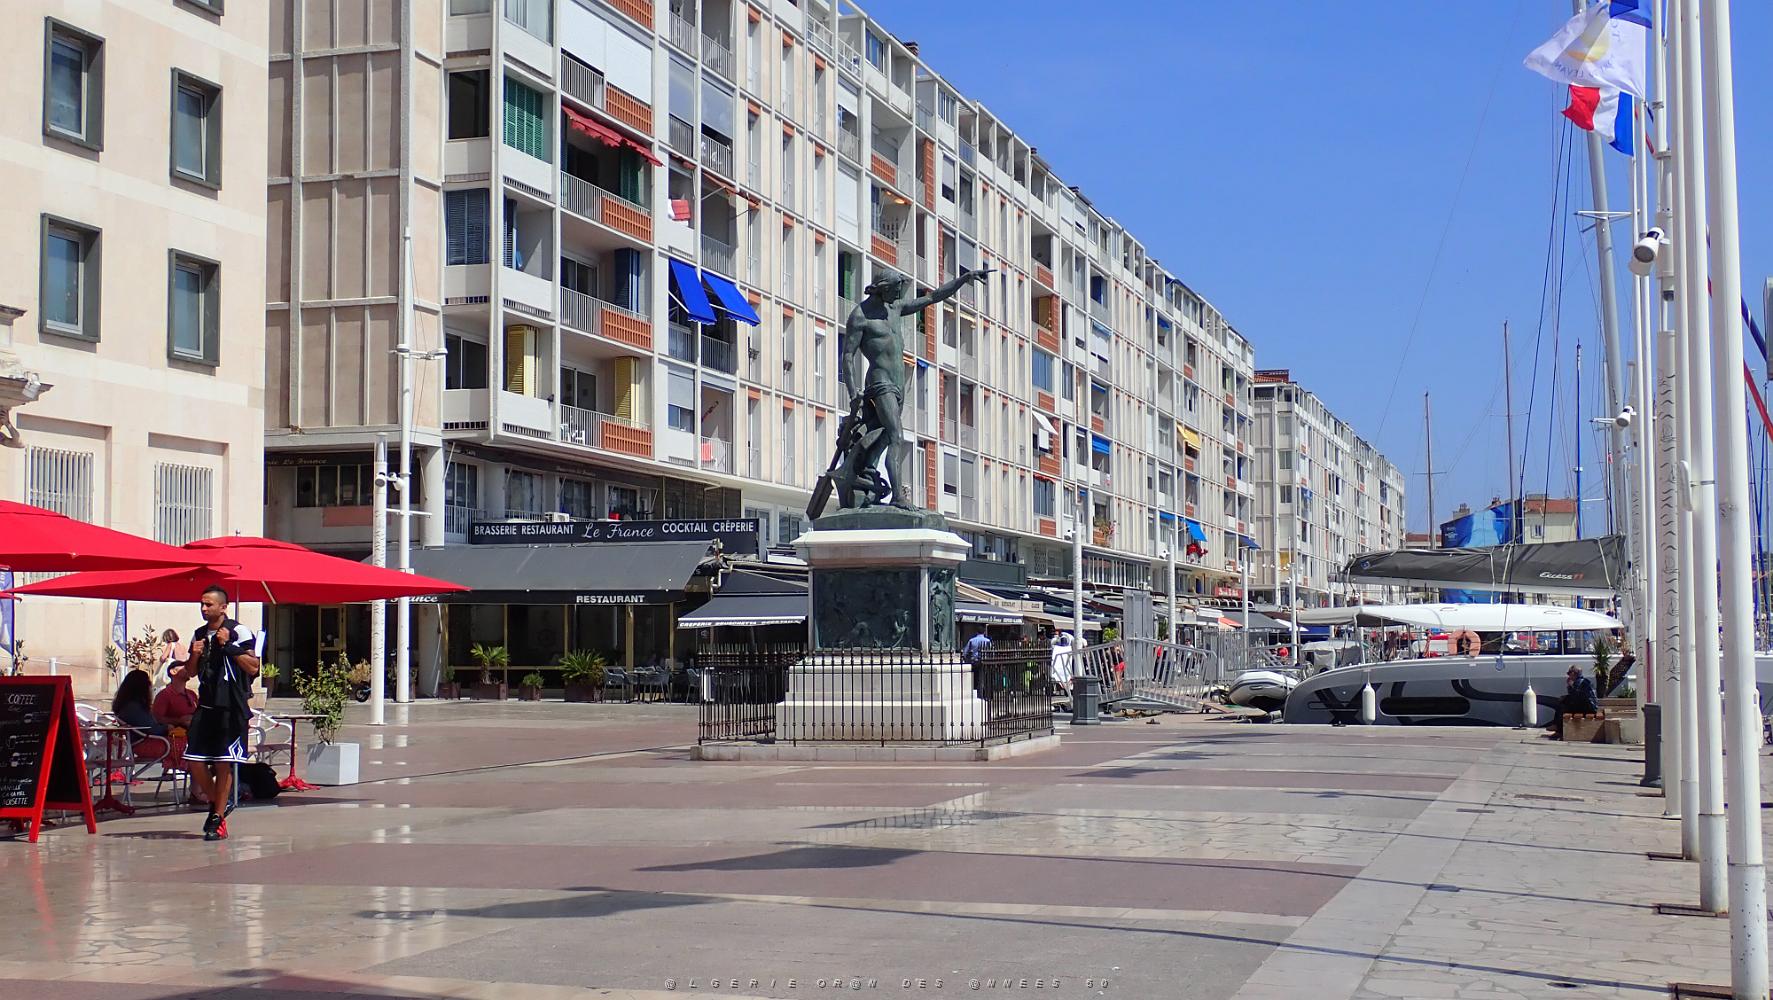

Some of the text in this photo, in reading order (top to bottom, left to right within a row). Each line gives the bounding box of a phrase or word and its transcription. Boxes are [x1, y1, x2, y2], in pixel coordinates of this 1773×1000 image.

[474, 520, 754, 539] BRASSERIE RESTAURANT Le France COCKTAIL CRÊPERIE
[576, 595, 645, 604] RESTAURANT
